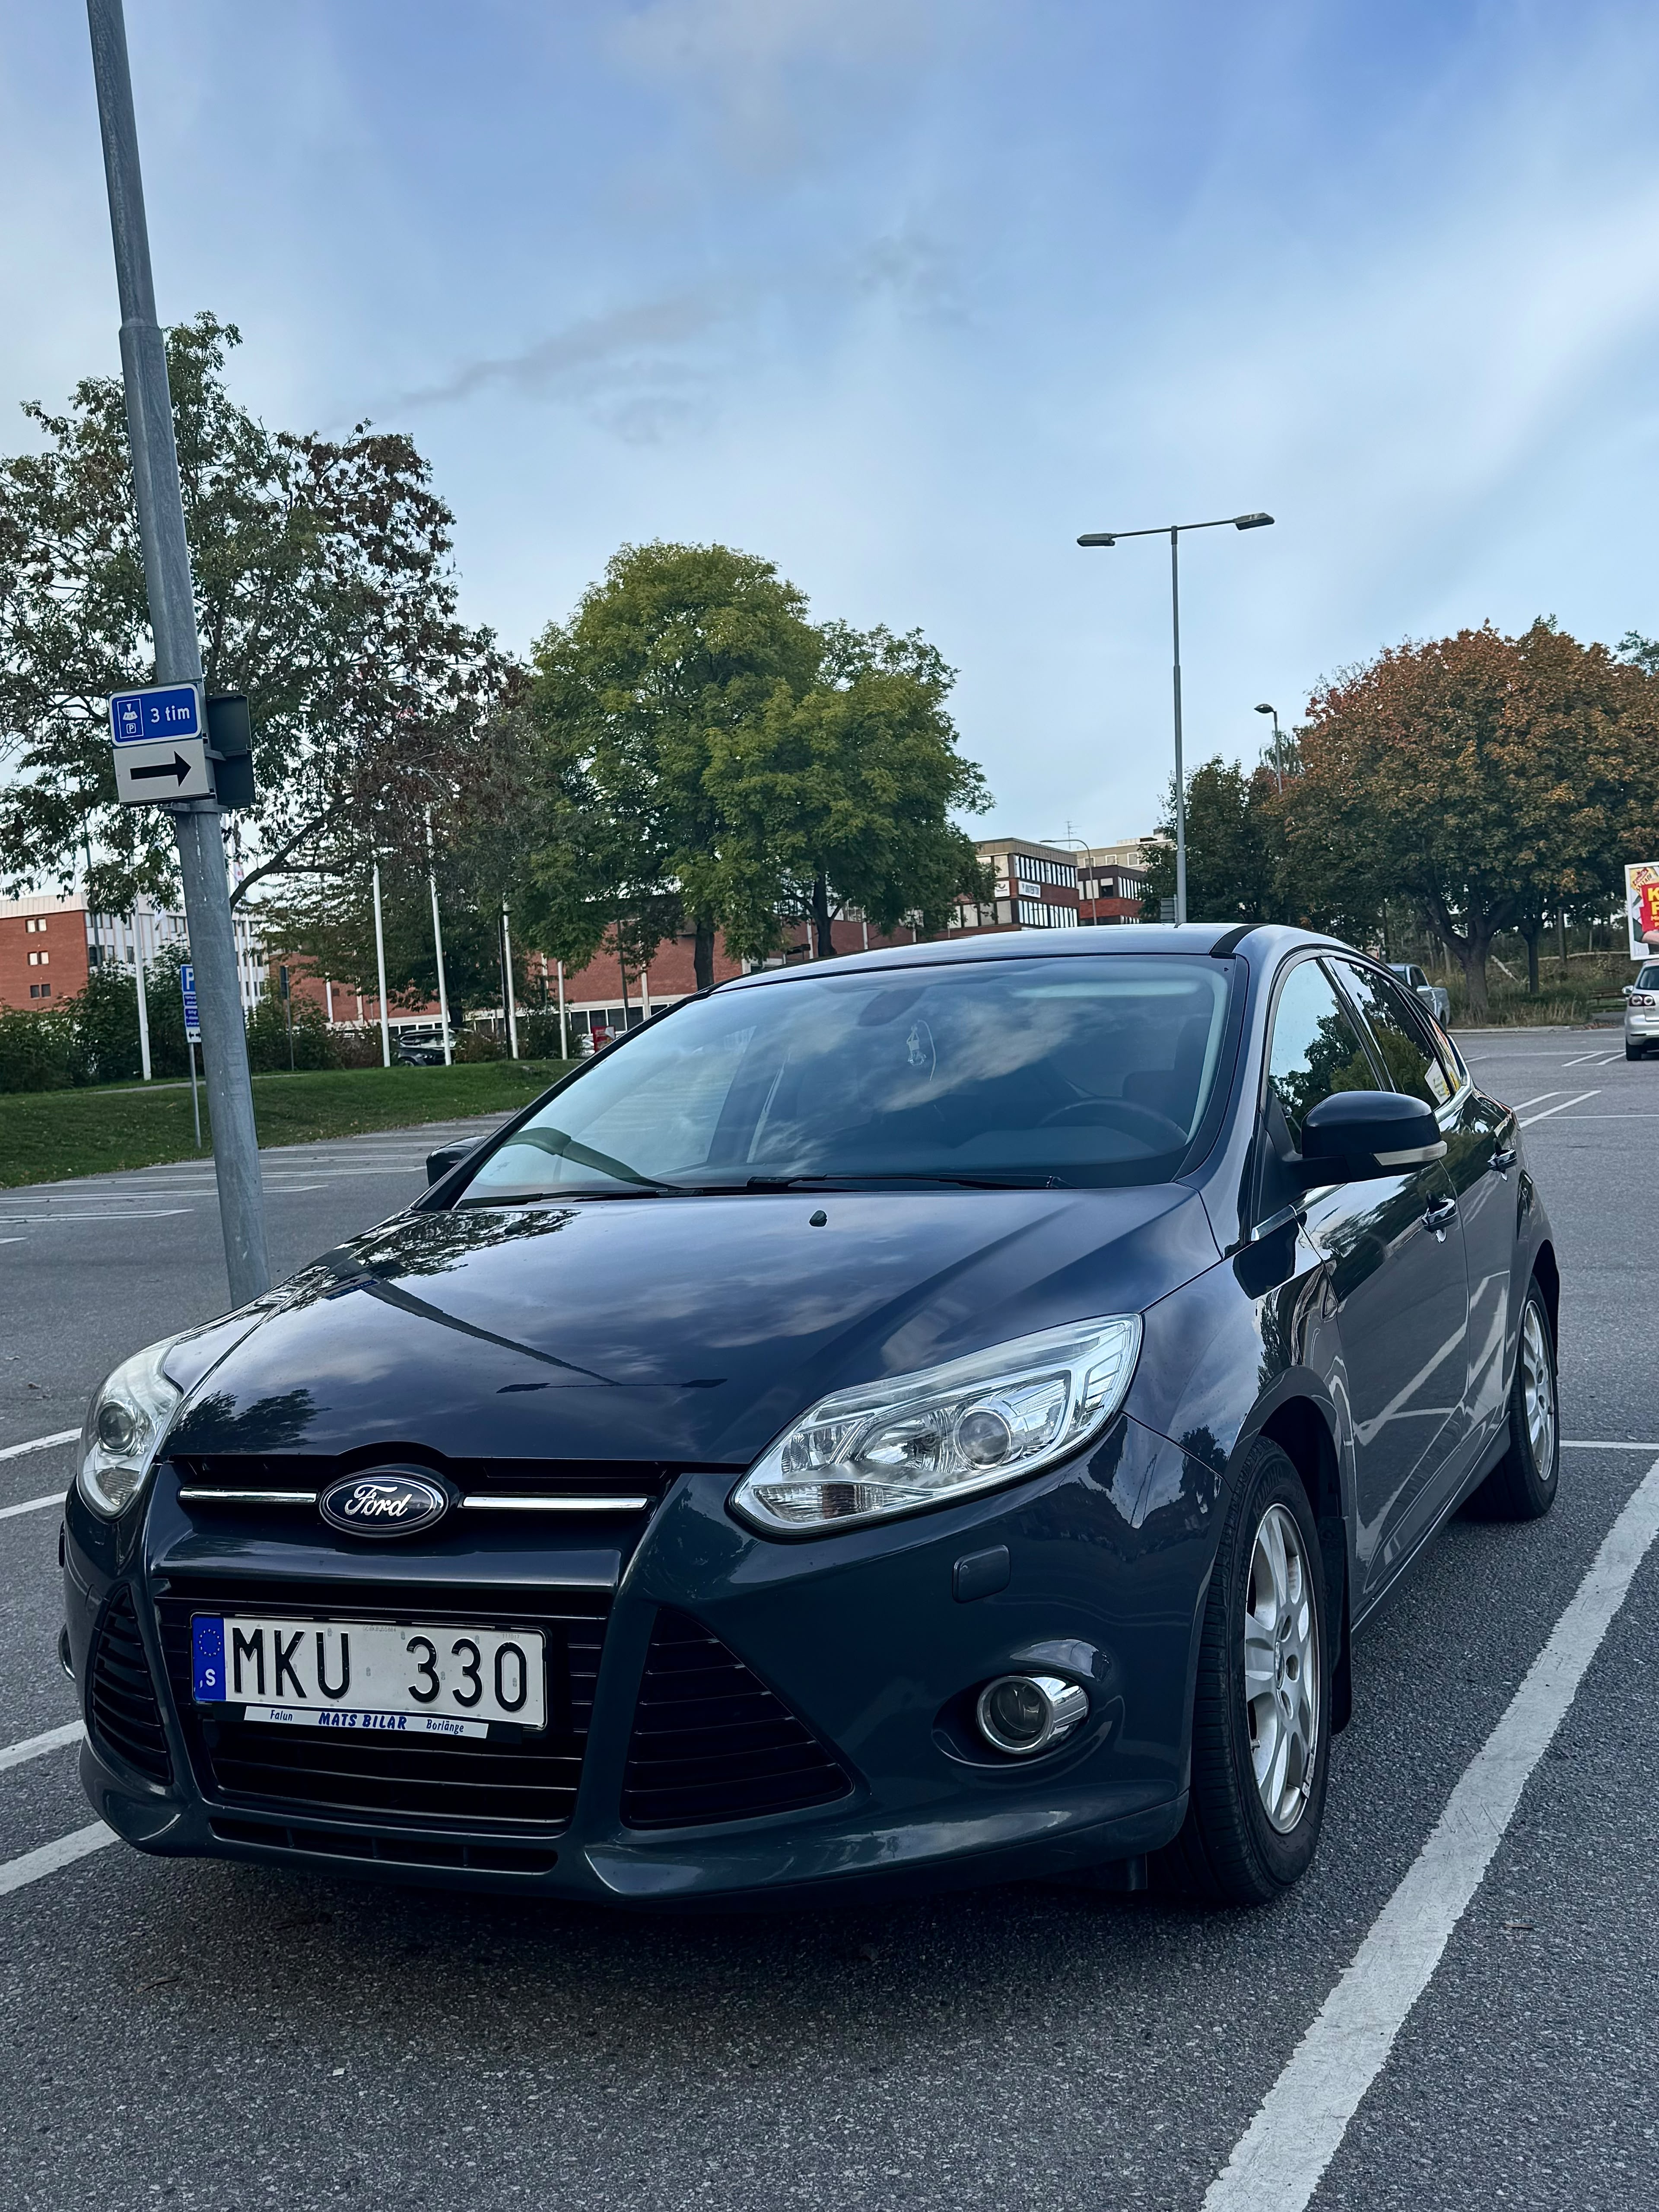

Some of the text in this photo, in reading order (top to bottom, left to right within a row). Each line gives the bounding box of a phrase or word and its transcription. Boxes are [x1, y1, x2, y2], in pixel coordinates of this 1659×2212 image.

[151, 705, 190, 723] 3 tim
[186, 967, 194, 990] P
[344, 1484, 413, 1517] Ford
[205, 1669, 216, 1686] S
[232, 1627, 528, 1712] MKU 330
[270, 1710, 464, 1735] Falun MATS BILAR Borlänge
